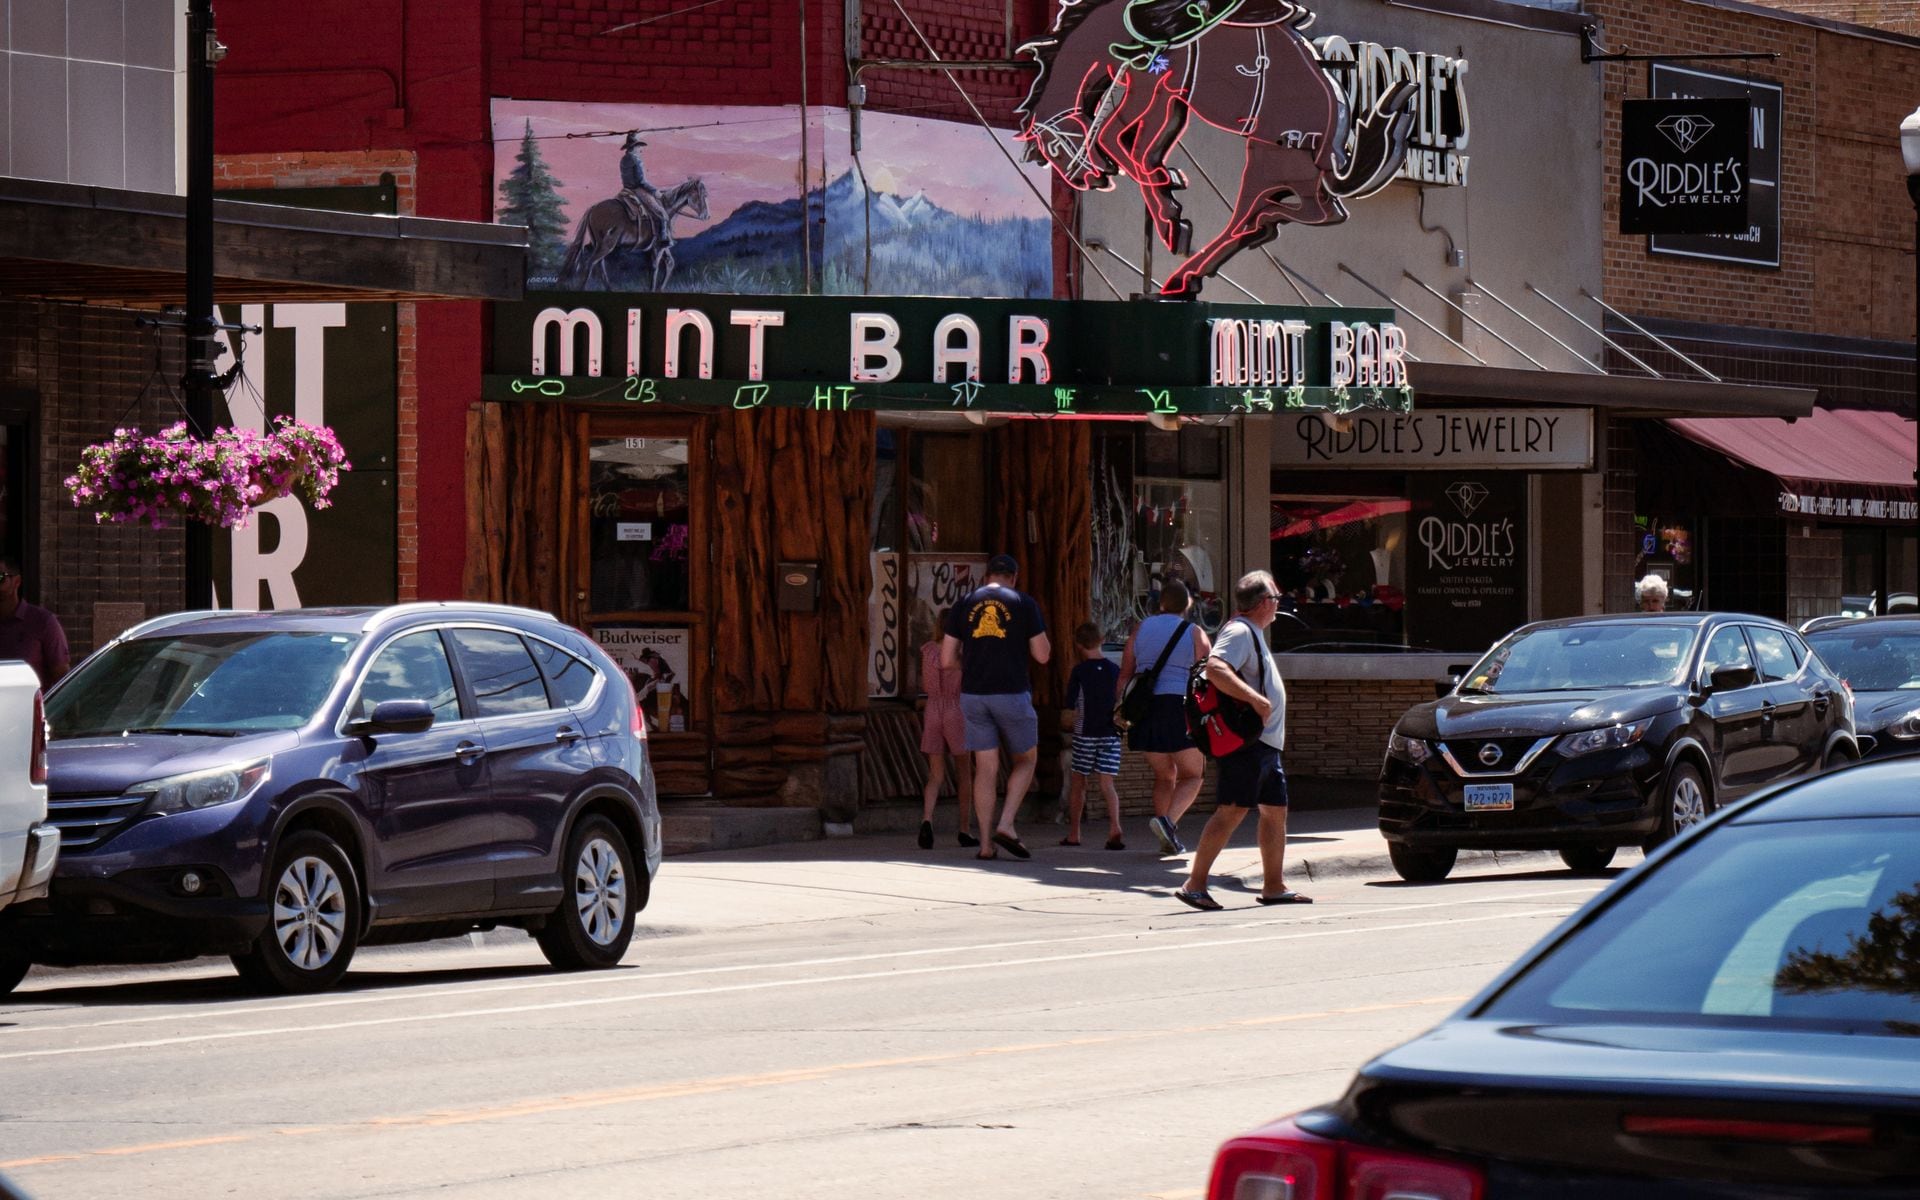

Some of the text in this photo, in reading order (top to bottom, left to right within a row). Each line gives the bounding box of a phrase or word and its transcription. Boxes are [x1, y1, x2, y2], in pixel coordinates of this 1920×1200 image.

[1396, 148, 1470, 187] WELRY
[1627, 157, 1742, 207] RIDDLE'S
[1669, 195, 1741, 204] JEWELRY
[532, 307, 1049, 384] MINT BAR
[1211, 318, 1406, 388] MINT BAR
[627, 438, 645, 448] 151
[1296, 414, 1560, 461] RIDDLE'S JEWELRY
[1418, 516, 1514, 570] RIDDLE'S
[1455, 558, 1514, 567] JEWELRY
[599, 630, 682, 644] Budweiser
[875, 555, 897, 695] Coors
